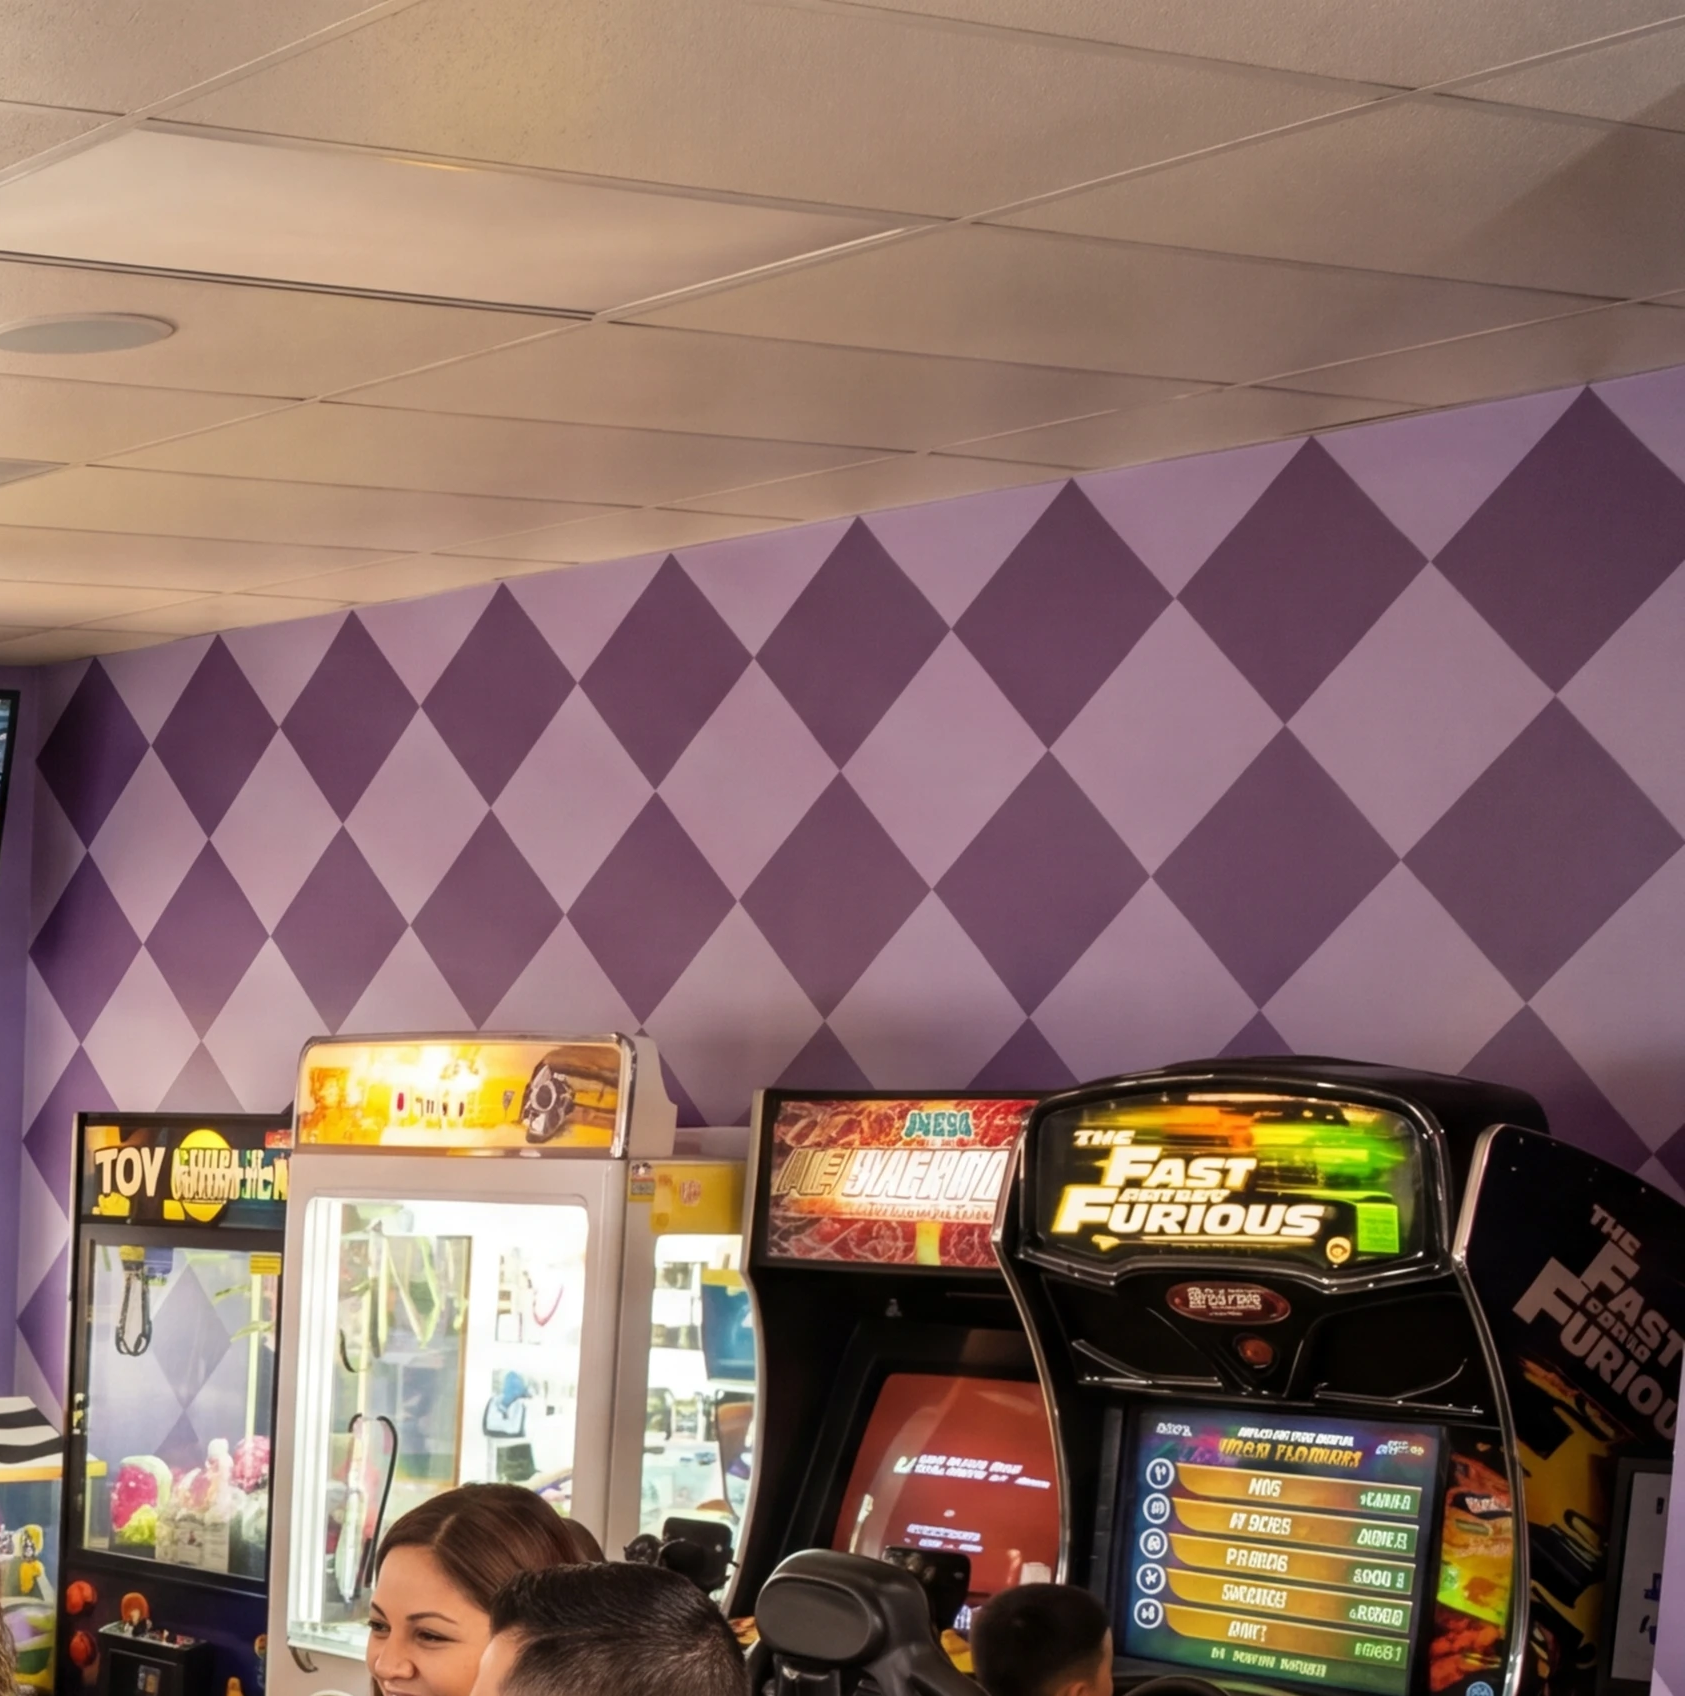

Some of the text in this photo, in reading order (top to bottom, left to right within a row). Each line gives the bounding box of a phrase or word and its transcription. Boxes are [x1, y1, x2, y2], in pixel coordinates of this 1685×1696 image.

[1073, 1130, 1136, 1147] THE
[1101, 1145, 1258, 1190] FAST
[1051, 1185, 1326, 1236] FURIOUS
[1589, 1204, 1642, 1257] THE
